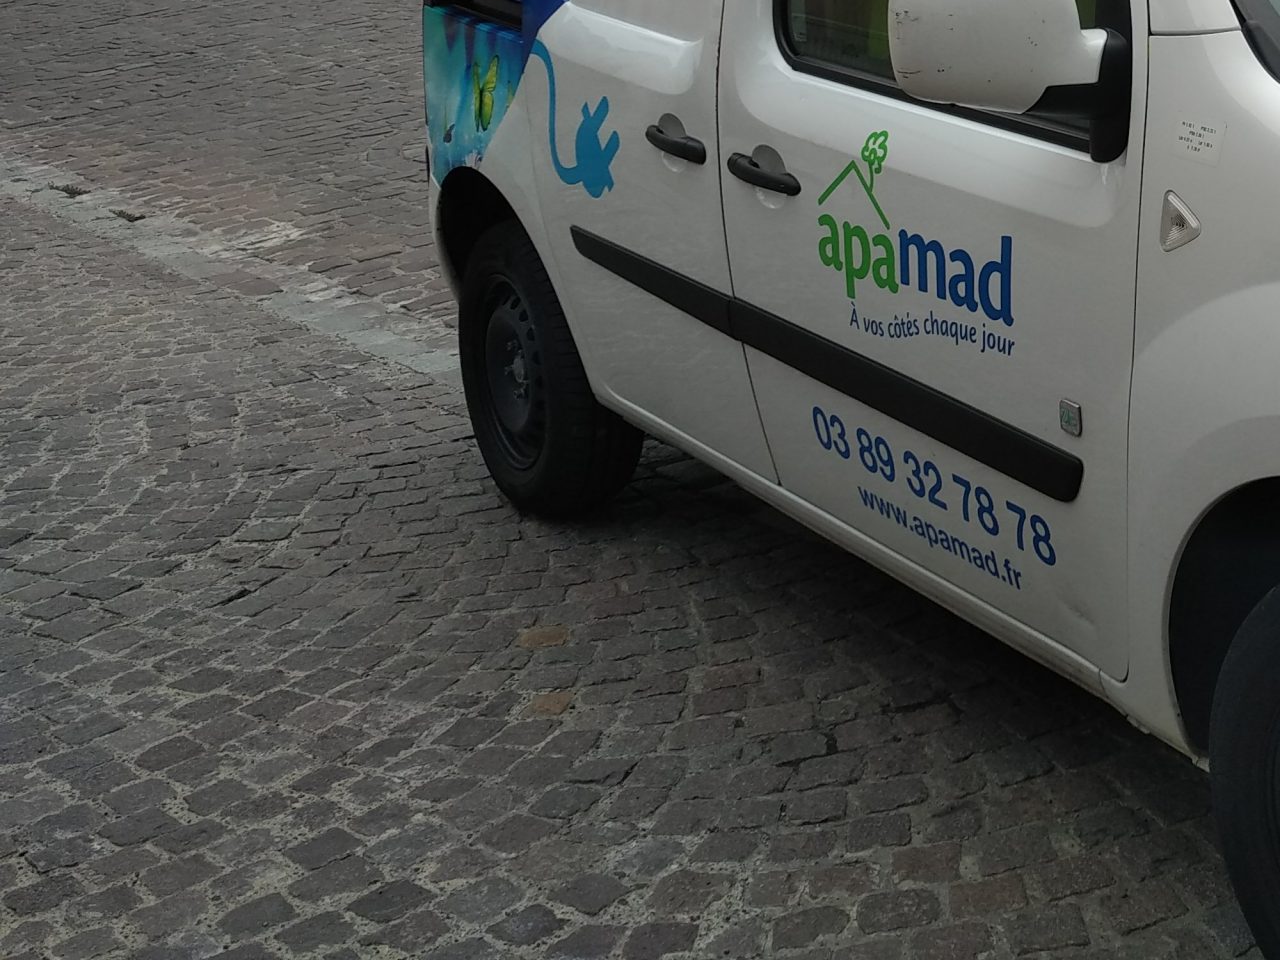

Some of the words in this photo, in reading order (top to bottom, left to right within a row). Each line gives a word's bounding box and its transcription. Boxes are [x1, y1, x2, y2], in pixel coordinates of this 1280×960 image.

[818, 213, 1014, 327] apamad
[850, 302, 860, 329] À
[863, 316, 884, 336] vos
[887, 311, 920, 339] côtés
[923, 310, 978, 345] chaque
[980, 323, 1016, 357] jour
[812, 406, 851, 460] 03
[856, 427, 896, 483] 89
[903, 450, 948, 511] 32
[952, 473, 1000, 536] 78
[1006, 500, 1057, 566] 78
[857, 485, 1023, 590] www.apamad.fr
